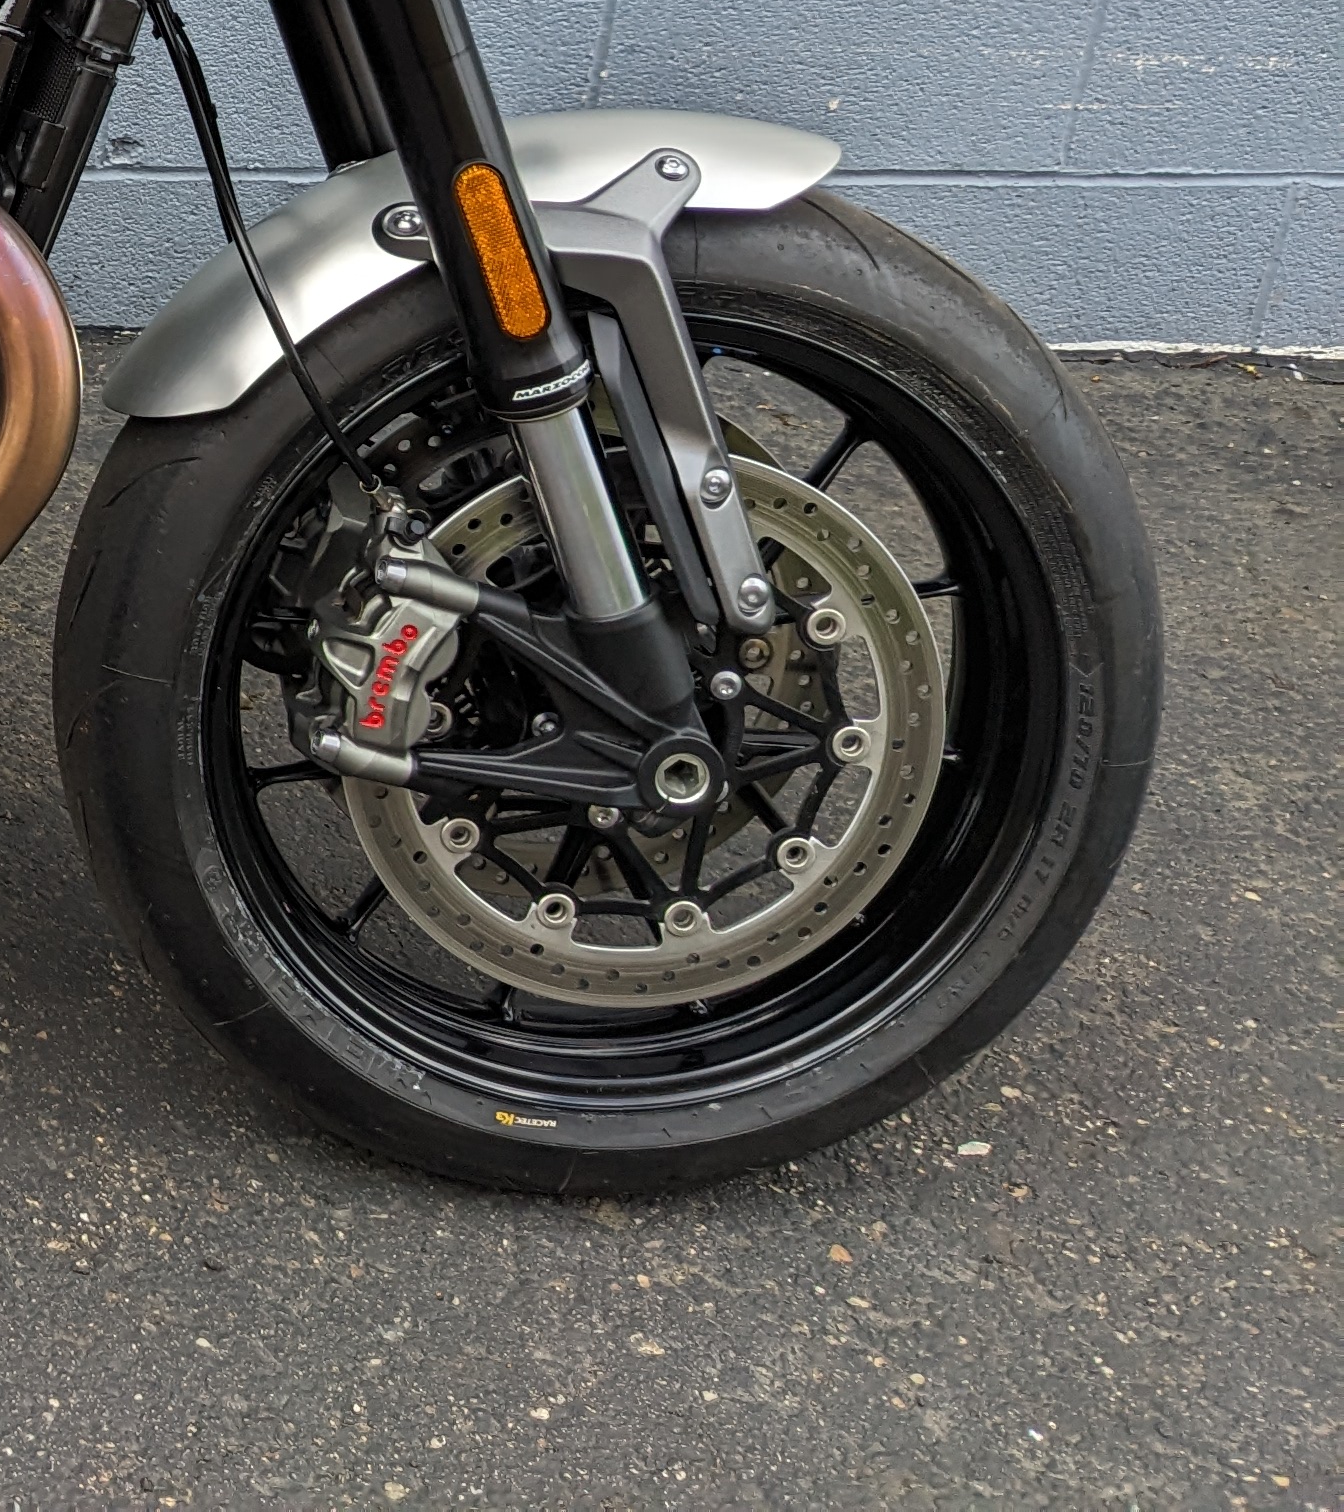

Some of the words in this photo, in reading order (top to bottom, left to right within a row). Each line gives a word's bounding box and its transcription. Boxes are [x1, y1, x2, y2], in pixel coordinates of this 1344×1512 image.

[359, 624, 419, 729] brembo
[495, 1111, 515, 1126] K3
[514, 1116, 558, 1128] RACETEC
